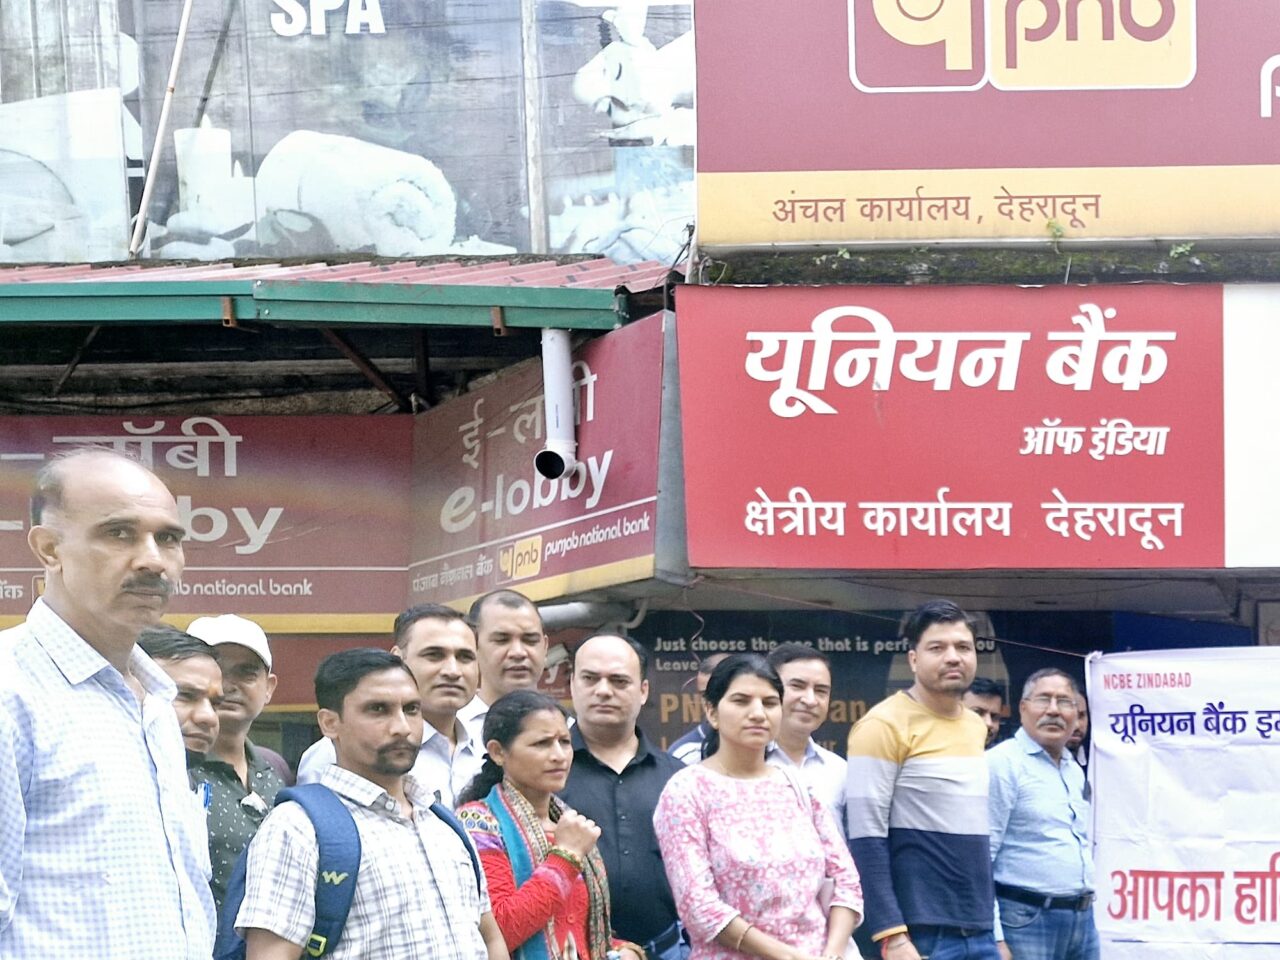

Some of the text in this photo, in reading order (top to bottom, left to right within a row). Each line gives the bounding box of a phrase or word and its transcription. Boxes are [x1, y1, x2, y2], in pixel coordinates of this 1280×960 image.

[270, 0, 386, 37] SPA
[772, 190, 846, 223] अंचल
[994, 186, 1102, 229] देहरादून
[744, 304, 1177, 417] यूनियन बैंक
[1019, 418, 1171, 461] ऑफ इंडिया
[579, 518, 622, 547] national
[623, 510, 650, 536] bank
[743, 488, 1185, 549] क्षेत्रीय कार्यालय देहरादून
[193, 579, 267, 596] national
[269, 578, 313, 596] bank
[655, 637, 686, 652] Just
[691, 637, 746, 651] choose
[818, 637, 852, 652] that
[856, 637, 869, 652] is
[874, 637, 910, 654] perf
[975, 640, 996, 651] ou
[1103, 672, 1192, 690] NCBE ZINDABAD
[1108, 704, 1196, 744] यूनियन
[1203, 701, 1249, 736] बैंक
[1107, 870, 1225, 922] आपका
